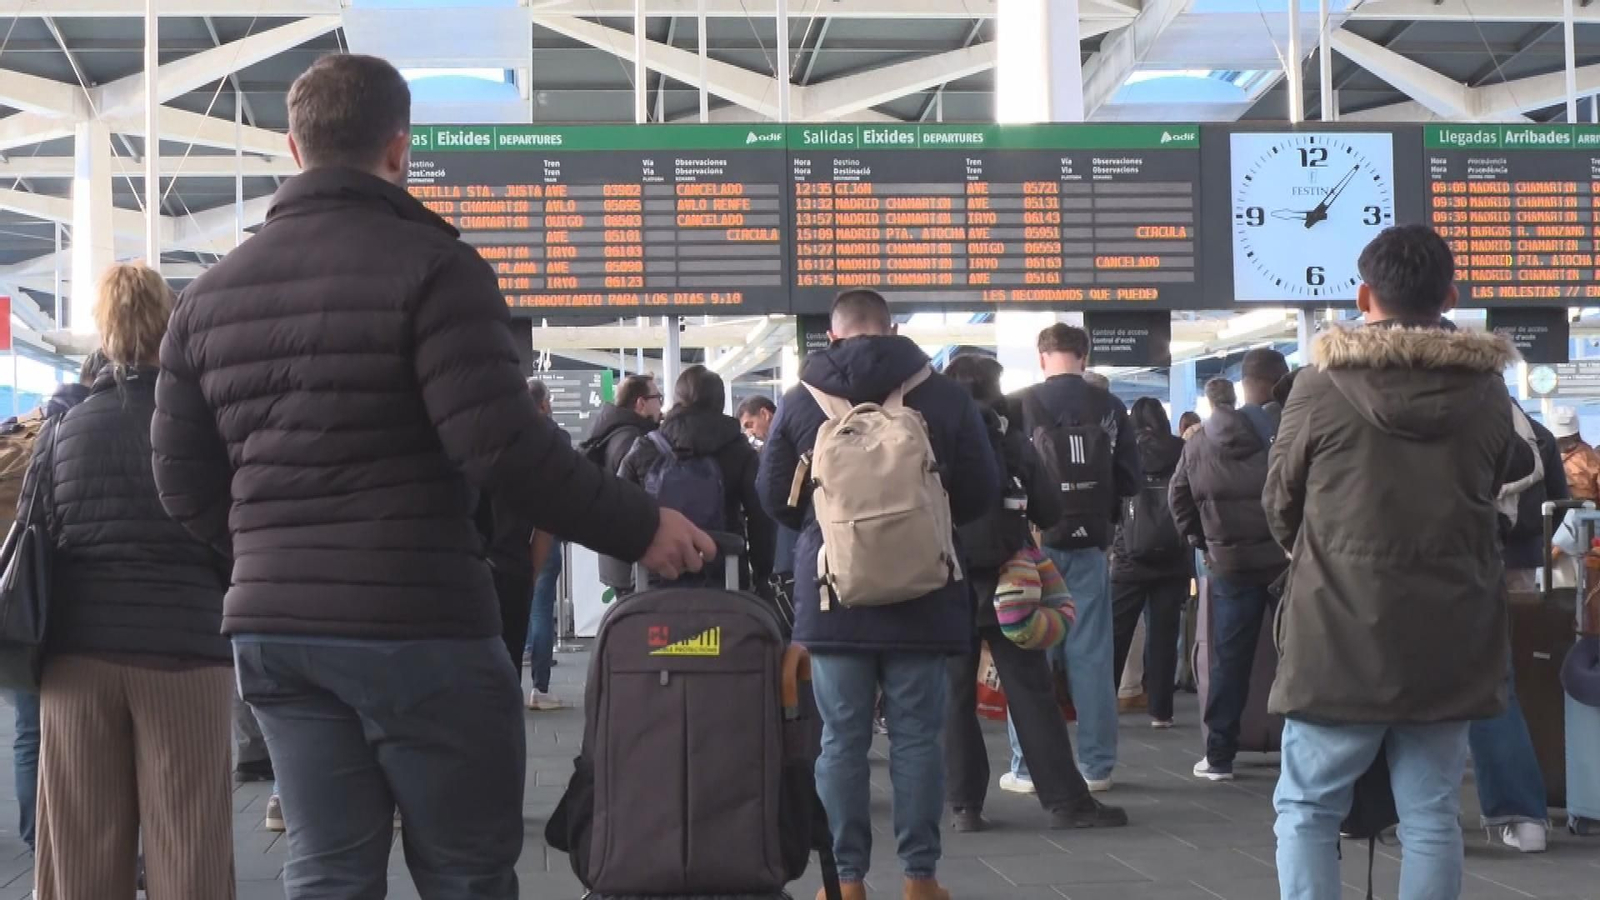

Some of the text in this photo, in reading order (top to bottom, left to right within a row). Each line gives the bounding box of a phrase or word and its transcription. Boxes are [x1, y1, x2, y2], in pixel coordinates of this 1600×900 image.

[437, 132, 490, 145] Eixides
[499, 135, 562, 145] DEPARTURES
[758, 133, 782, 142] adif
[803, 130, 984, 144] Salidas Eixides DEPARTURES
[1172, 133, 1195, 141] adif
[1440, 130, 1600, 145] Llegadas Arribades ARRI
[543, 159, 560, 167] Tren
[794, 158, 811, 166] Hora
[833, 158, 860, 166] Destino
[1092, 157, 1143, 165] Observaciones
[1297, 147, 1328, 168] 12
[543, 168, 560, 176] Tren
[675, 167, 723, 175] Observacions
[794, 167, 811, 175] Hora
[833, 166, 871, 176] Destinació
[1092, 166, 1139, 174] Observacions
[545, 186, 567, 197] AVE
[676, 184, 742, 196] CANCELADO
[967, 183, 988, 194] AVE
[1468, 183, 1509, 193] MADRID
[546, 200, 576, 213] AVLO
[678, 199, 706, 211] AVLO
[714, 198, 750, 210] RENFE
[835, 197, 879, 210] MADRID
[968, 197, 989, 210] AVE
[1469, 197, 1510, 208] MADRID
[545, 215, 583, 227] OUIGO
[676, 214, 744, 227] CANCELADO
[835, 213, 879, 226] MADRID
[1246, 206, 1264, 226] 9
[1363, 206, 1381, 226] 3
[1469, 211, 1510, 223] MADRID
[546, 230, 568, 243] AVE
[726, 229, 779, 240] CIRCULA
[836, 227, 879, 240] MADRID
[922, 227, 965, 240] ATOCHA
[968, 227, 990, 240] AVE
[1136, 226, 1186, 238] CIRCULA
[1470, 226, 1511, 237] BURGOS
[836, 243, 880, 255] MADRID
[968, 243, 1004, 254] OUIGO
[1471, 240, 1511, 253] MADRID
[837, 259, 880, 270] MADRID
[1096, 257, 1159, 268] CANCELADO
[1471, 254, 1512, 267] MADRID
[1552, 254, 1592, 266] ATOCHA
[546, 262, 569, 274] AVE
[837, 274, 880, 285] MADRID
[969, 273, 990, 284] AVE
[1306, 266, 1325, 286] 6
[1471, 269, 1512, 281] MADRID
[1090, 290, 1110, 300] QUE
[1472, 287, 1494, 298] LAS
[1500, 287, 1560, 297] MOLESTIAS
[608, 294, 639, 306] PARA
[645, 294, 667, 304] LOS
[674, 294, 704, 304] DIAS
[589, 391, 601, 407] 4
